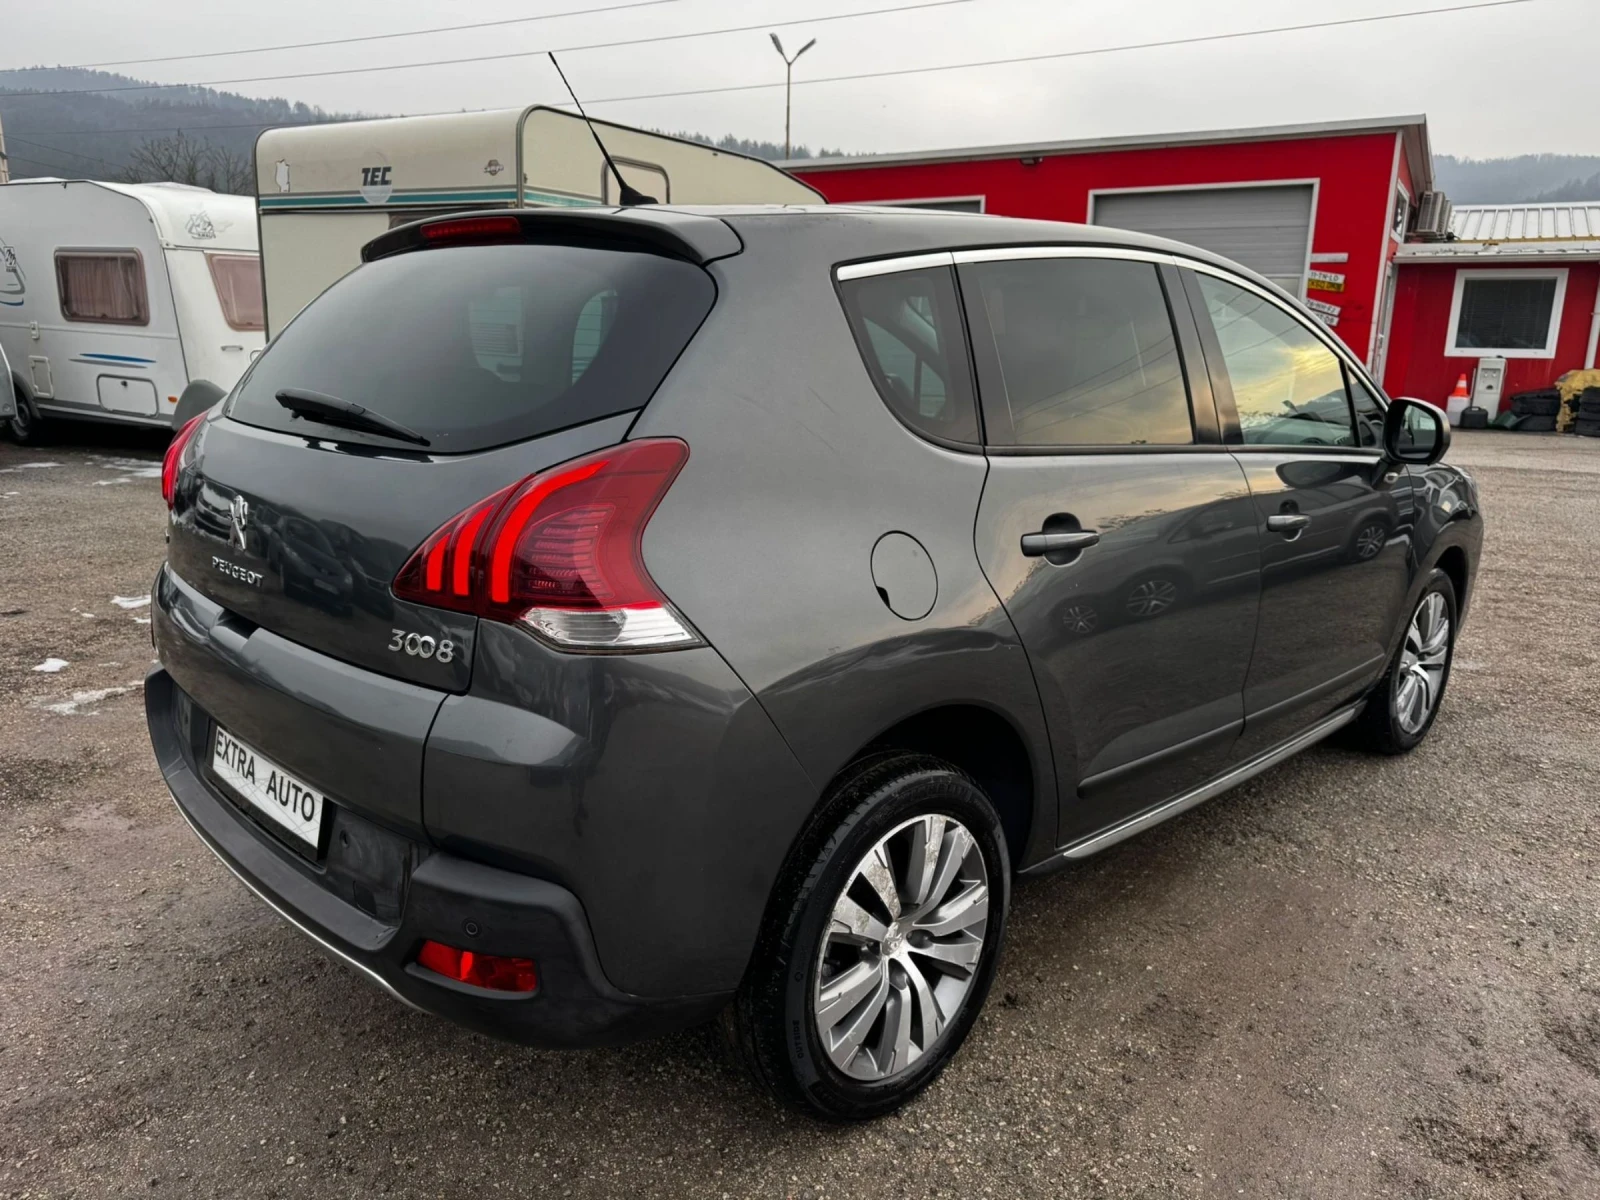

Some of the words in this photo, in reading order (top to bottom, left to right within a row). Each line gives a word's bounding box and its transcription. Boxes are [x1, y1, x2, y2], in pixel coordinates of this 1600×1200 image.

[361, 166, 392, 186] TEC
[212, 556, 264, 587] PEUGEOT
[388, 629, 454, 663] 3008
[215, 731, 255, 785] EXTRA
[266, 770, 315, 822] AUTO
